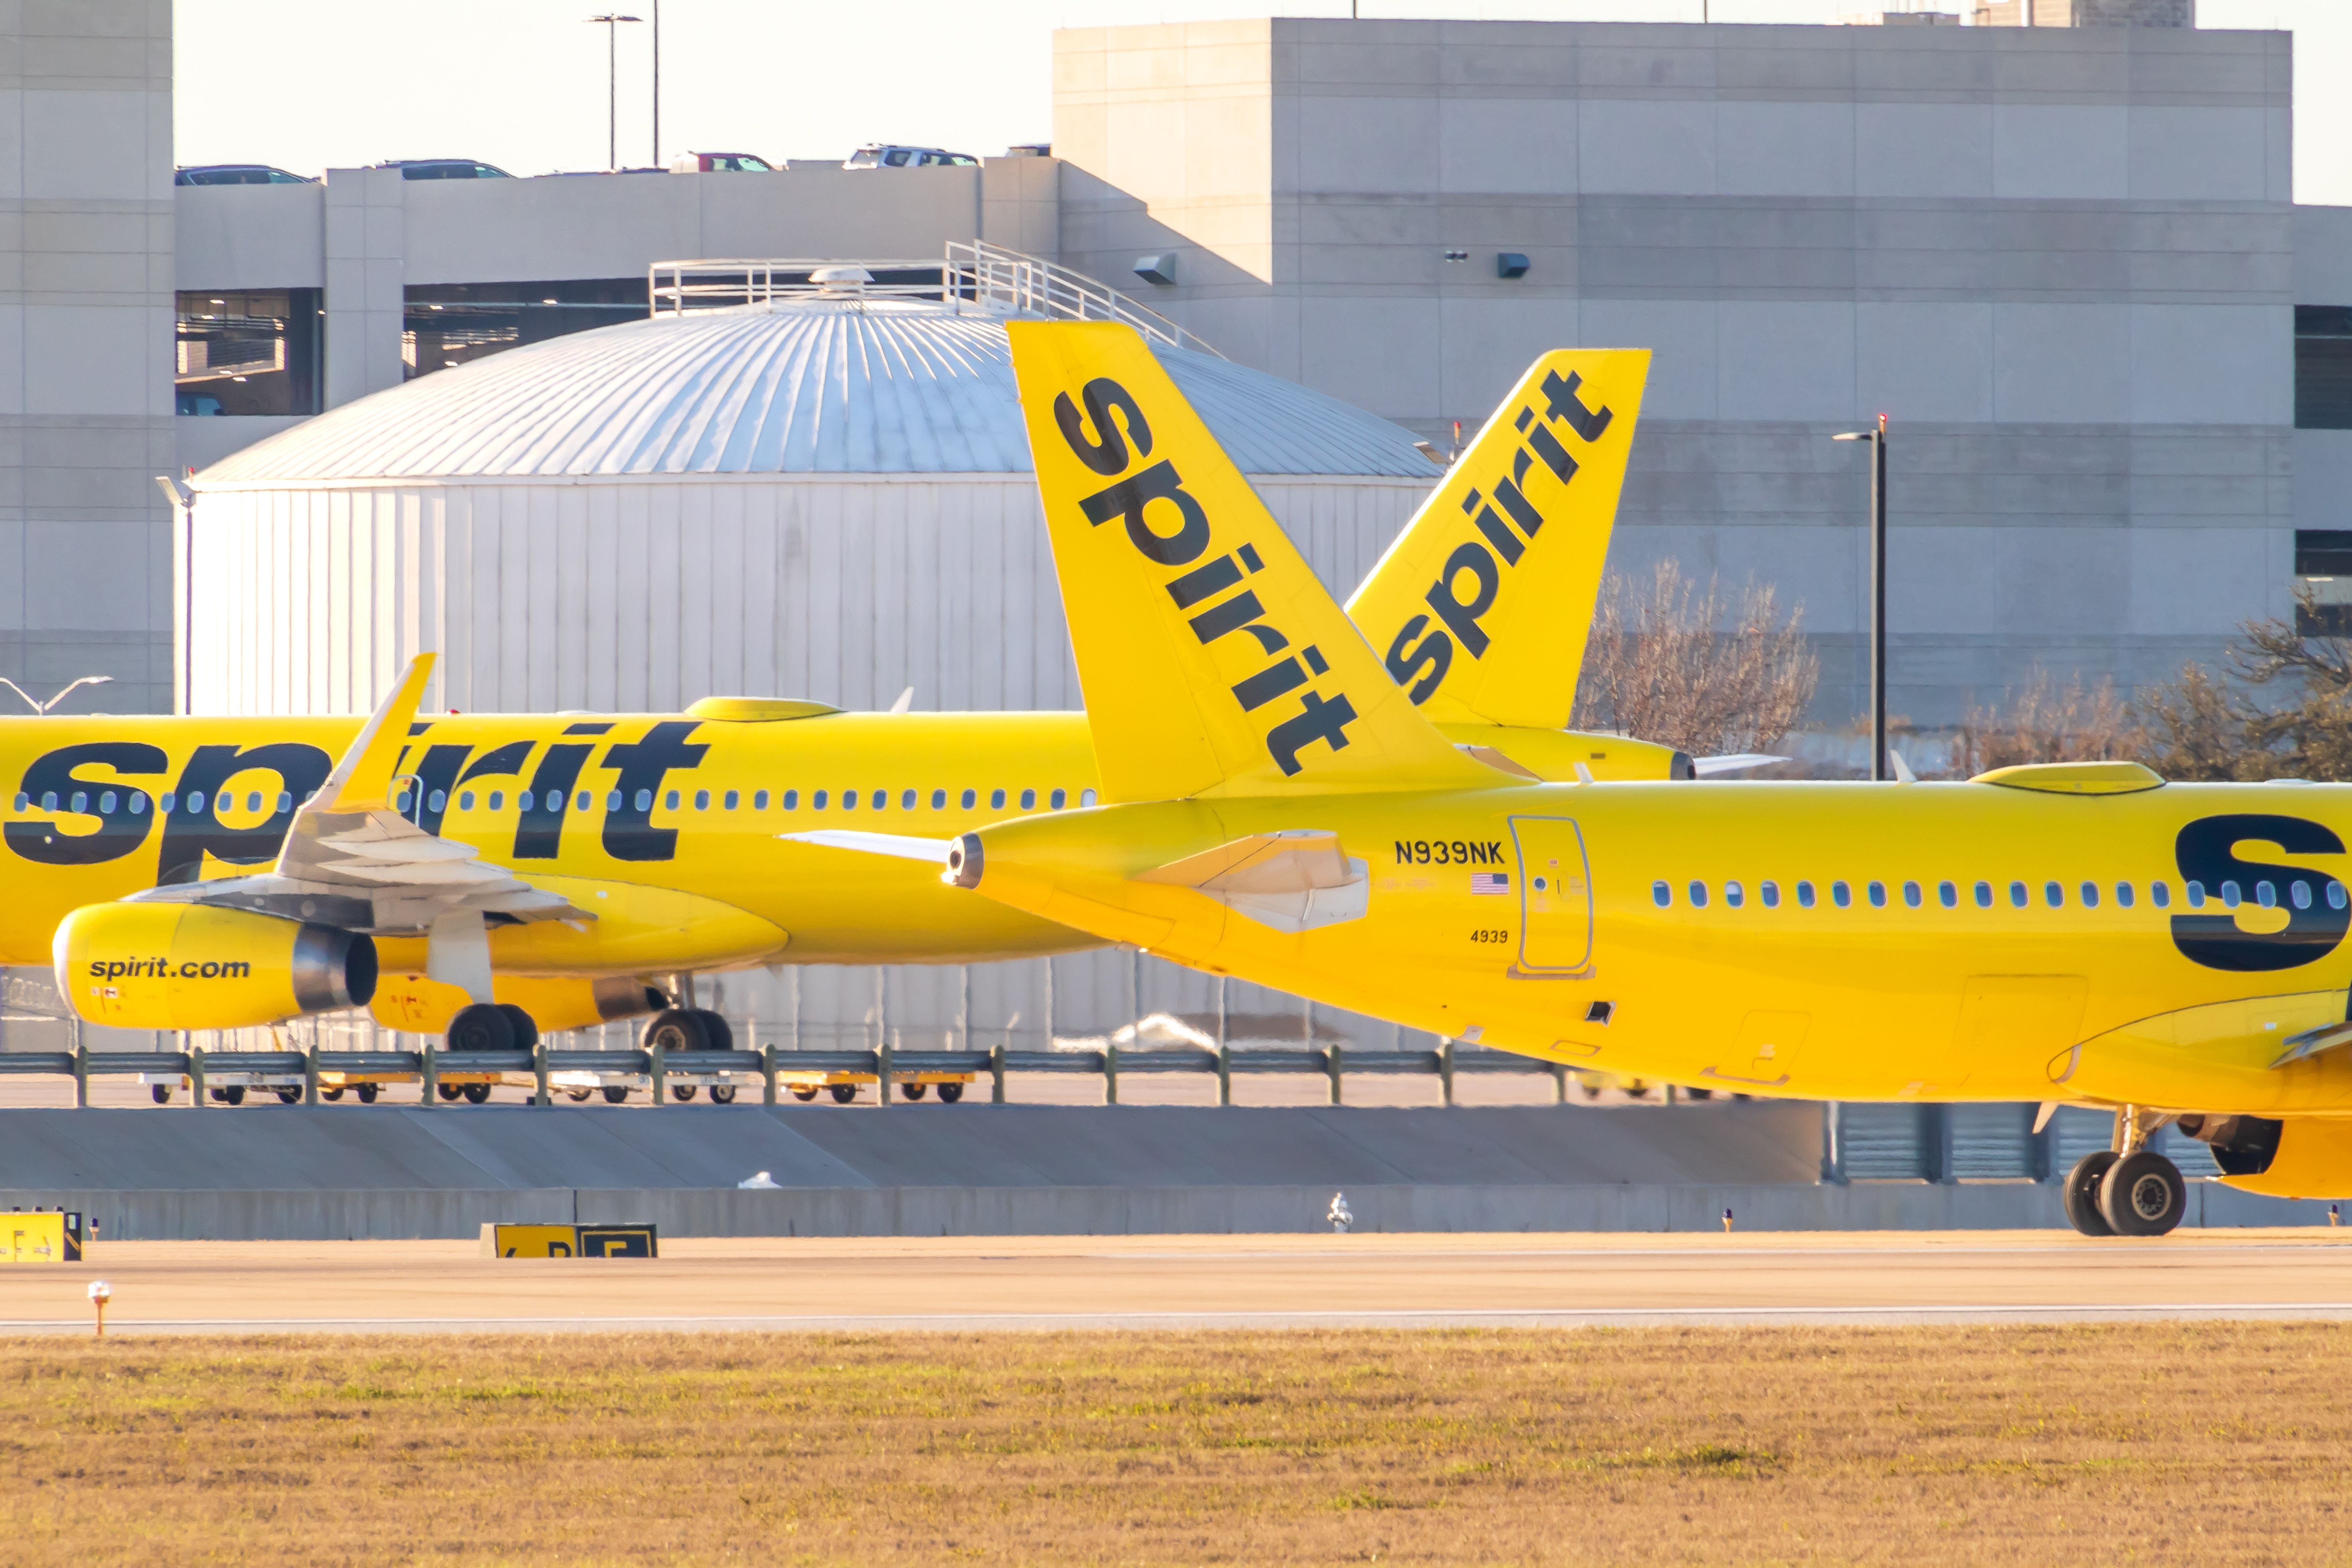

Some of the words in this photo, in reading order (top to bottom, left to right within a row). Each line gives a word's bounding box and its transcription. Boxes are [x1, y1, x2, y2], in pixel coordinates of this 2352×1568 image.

[1053, 377, 1358, 776] spirit
[1386, 369, 1614, 705] spirit
[4, 722, 710, 888] sprit
[1395, 840, 1505, 864] N939NK
[90, 956, 250, 981] spirit.com
[1470, 930, 1509, 944] 4939
[2164, 814, 2352, 1021] s
